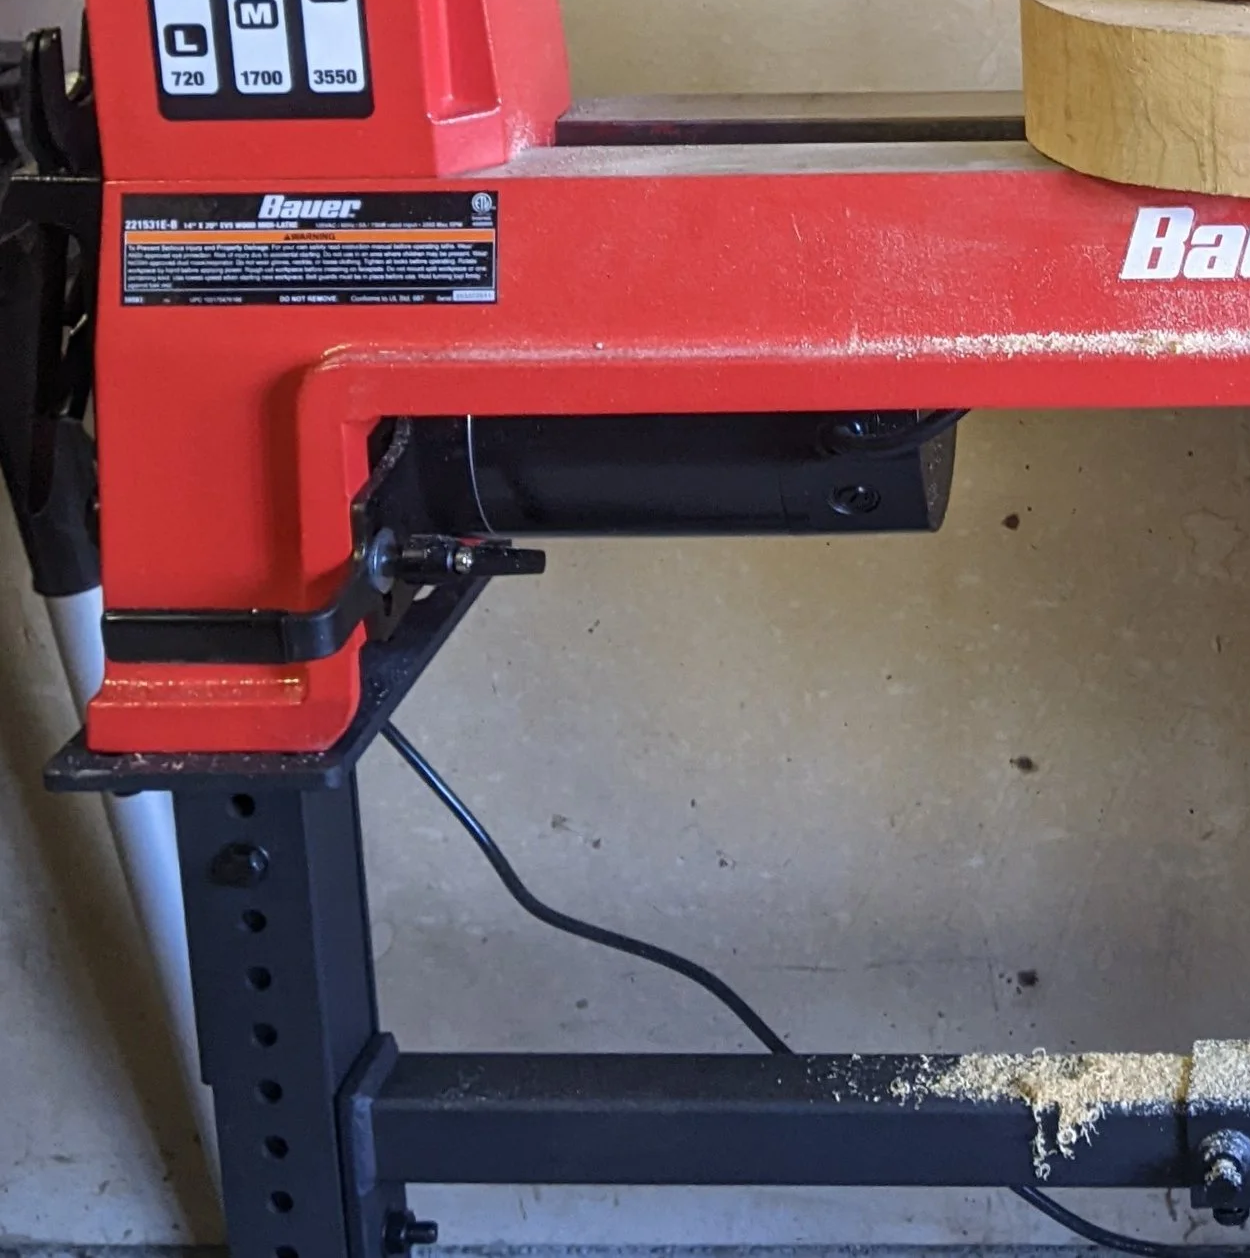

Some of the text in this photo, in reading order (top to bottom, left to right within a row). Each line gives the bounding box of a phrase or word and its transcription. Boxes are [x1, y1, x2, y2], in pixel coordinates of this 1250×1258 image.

[240, 3, 272, 25] M
[174, 30, 198, 52] L
[171, 71, 205, 87] 720
[240, 70, 283, 86] 1700
[313, 69, 357, 85] 3550
[258, 194, 361, 219] Bauer
